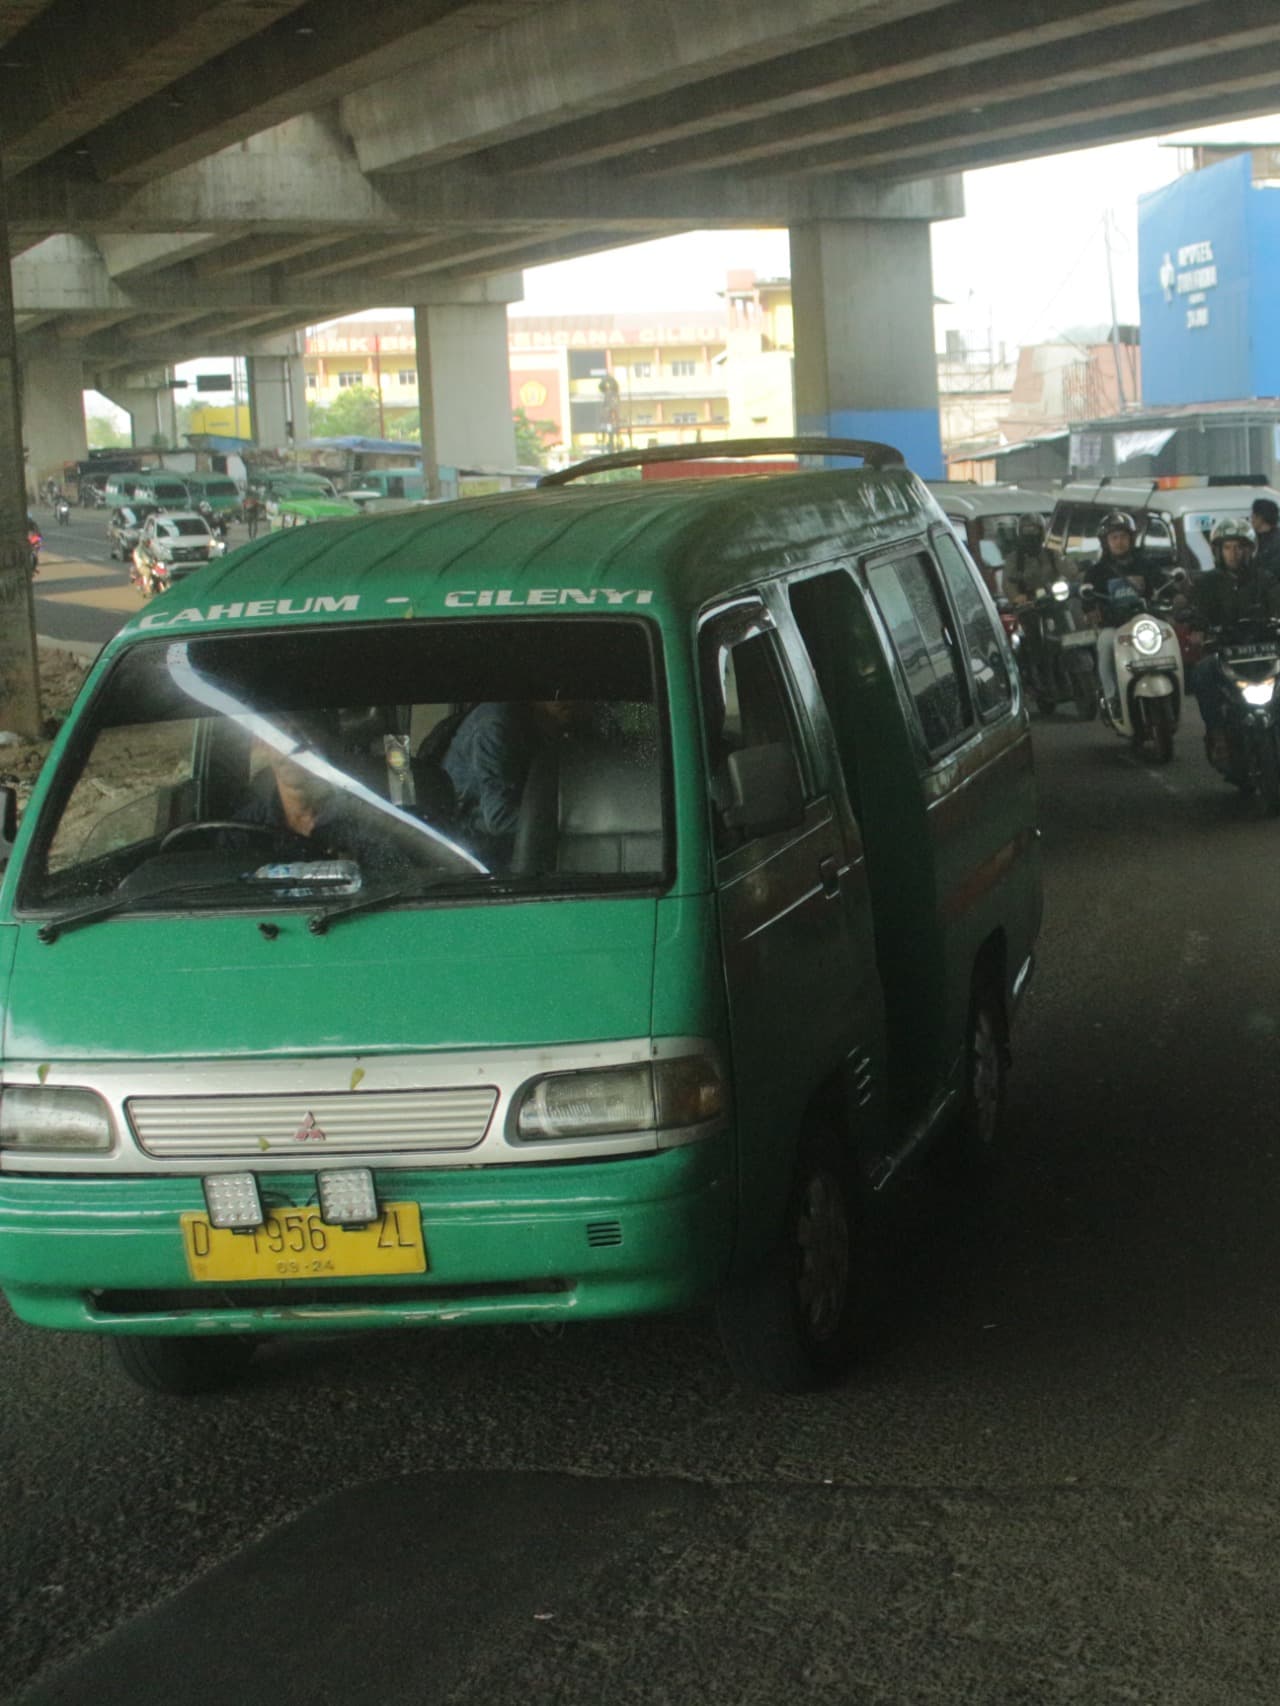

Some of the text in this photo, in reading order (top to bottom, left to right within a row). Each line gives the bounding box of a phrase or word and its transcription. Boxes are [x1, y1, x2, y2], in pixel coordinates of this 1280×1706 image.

[139, 594, 360, 630] CAHEUM
[444, 588, 654, 608] CILENYI
[191, 1220, 211, 1257] D
[377, 1210, 416, 1249] ZL
